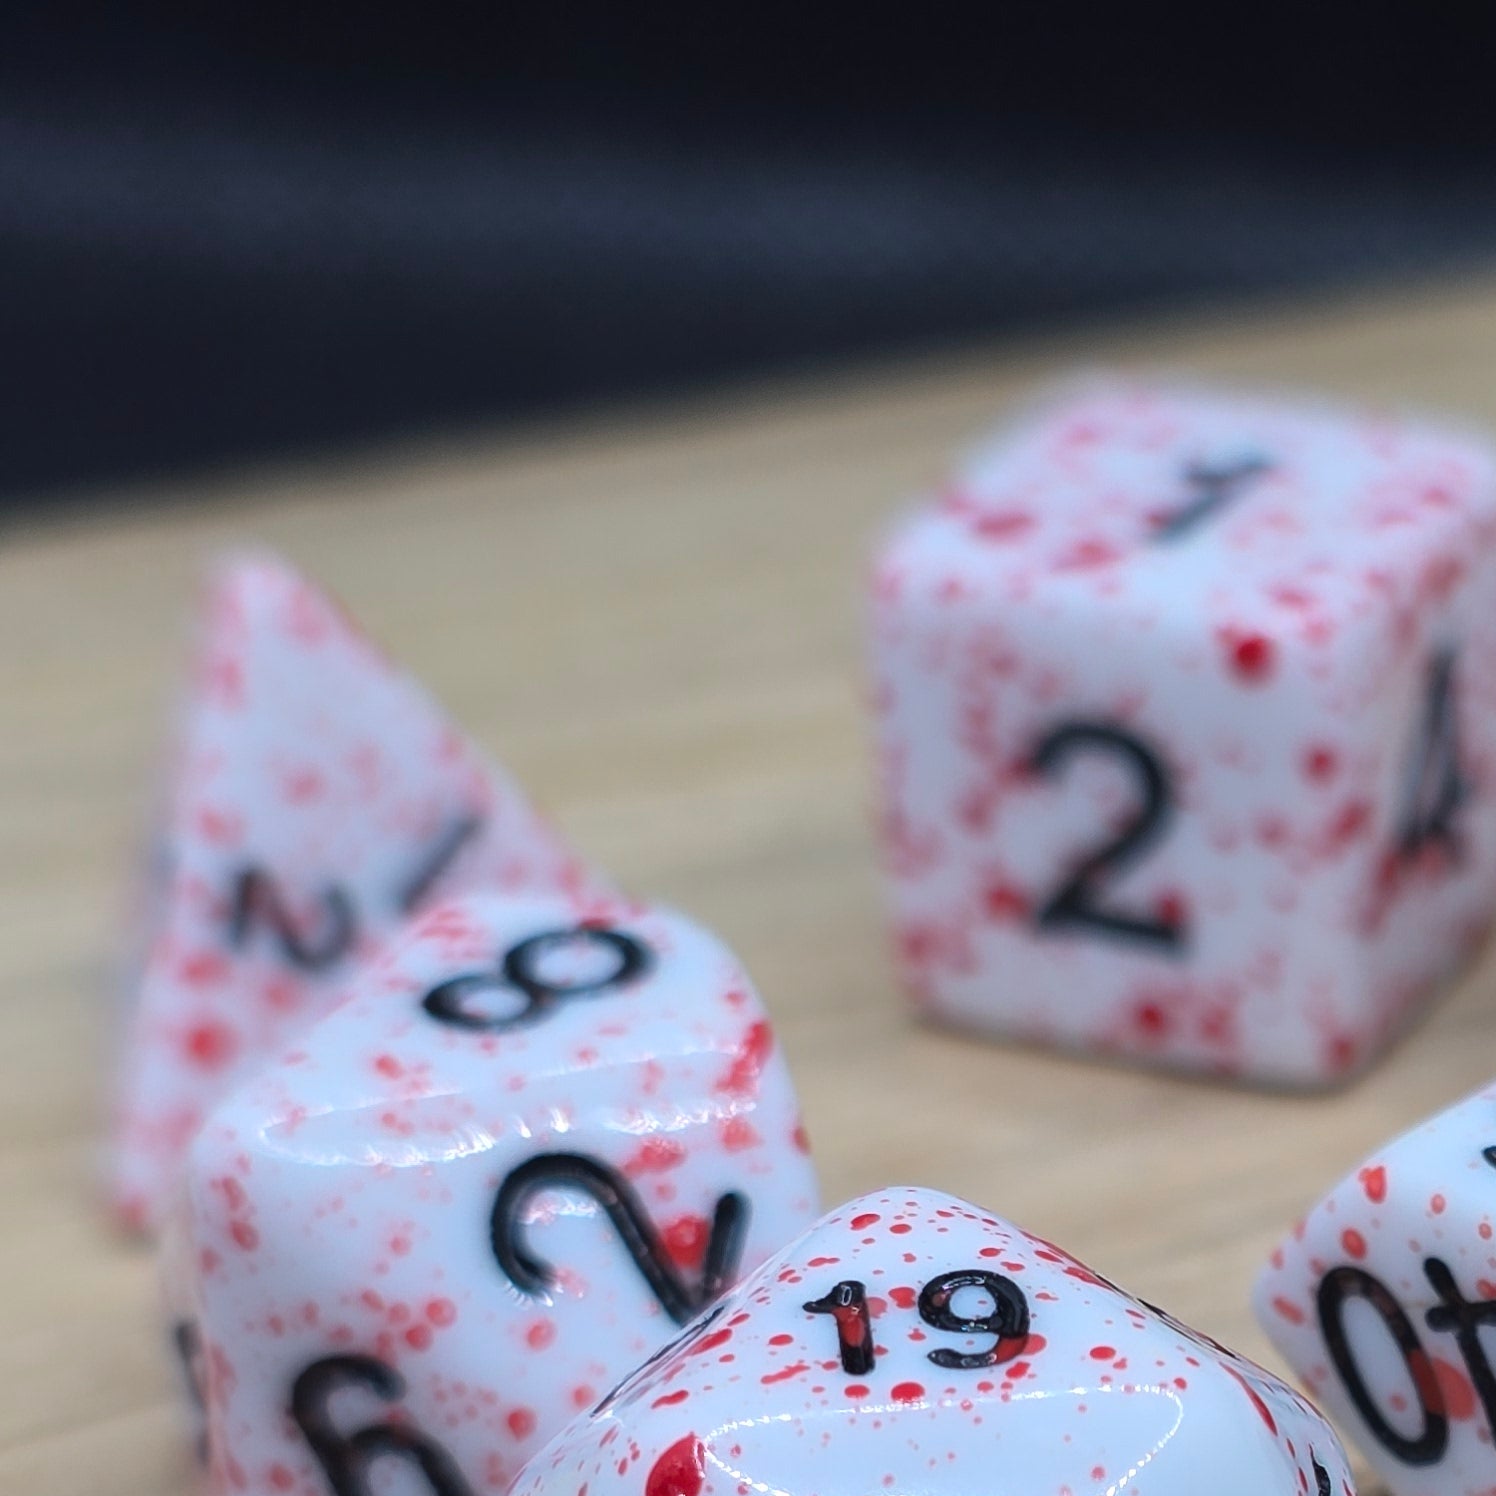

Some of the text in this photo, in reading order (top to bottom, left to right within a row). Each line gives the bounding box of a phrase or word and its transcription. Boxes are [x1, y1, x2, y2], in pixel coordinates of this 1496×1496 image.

[1028, 718, 1192, 955] 2
[420, 925, 657, 1035] 8
[490, 1152, 750, 1330] 2
[803, 1268, 1030, 1375] 19
